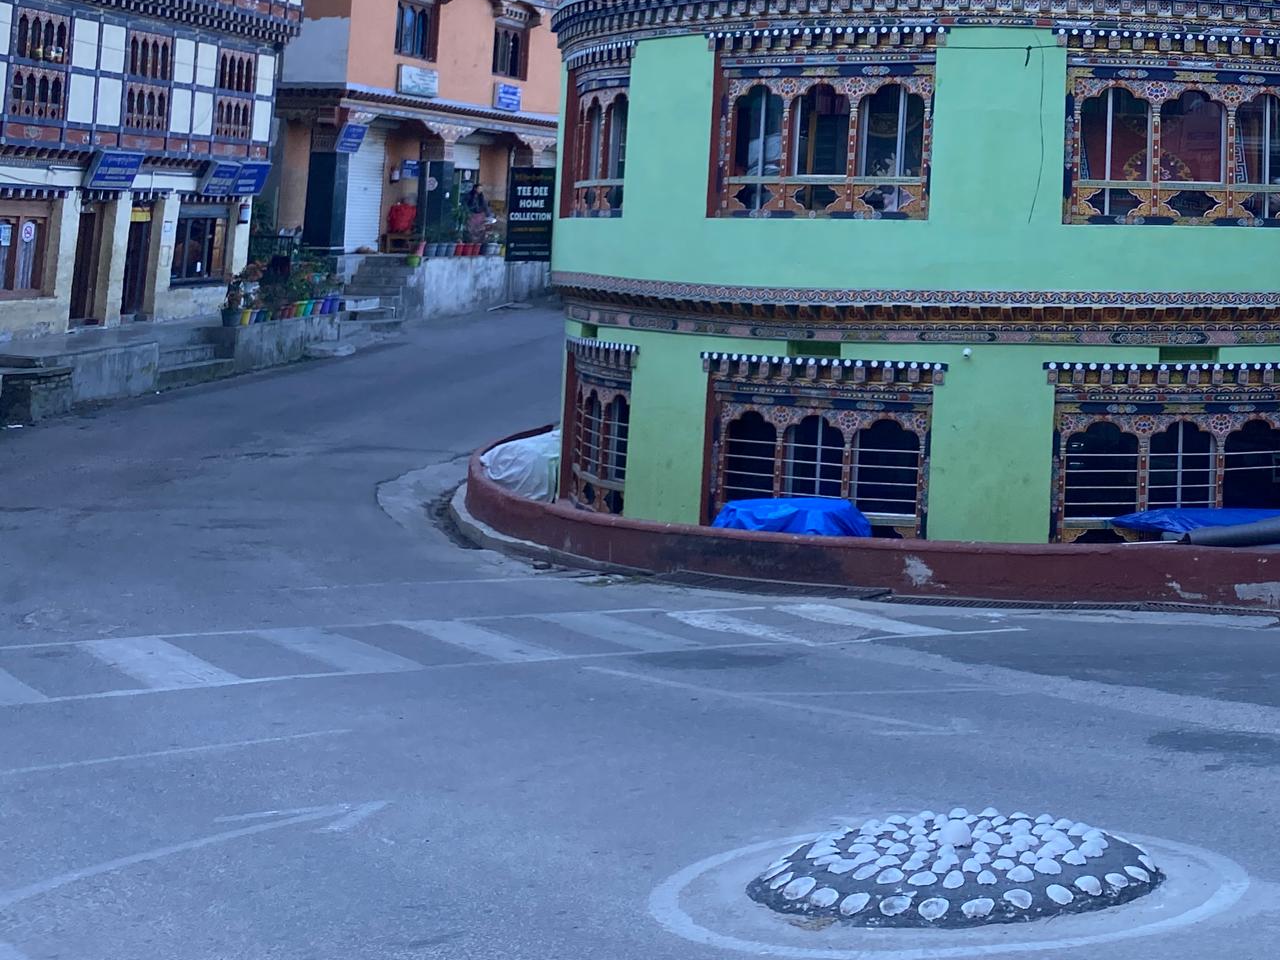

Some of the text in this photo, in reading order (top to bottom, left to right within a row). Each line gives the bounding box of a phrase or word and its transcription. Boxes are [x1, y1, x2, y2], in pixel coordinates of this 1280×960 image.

[517, 186, 549, 196] TEE DEE
[519, 199, 545, 208] HOME
[510, 212, 552, 221] COLLECTION
